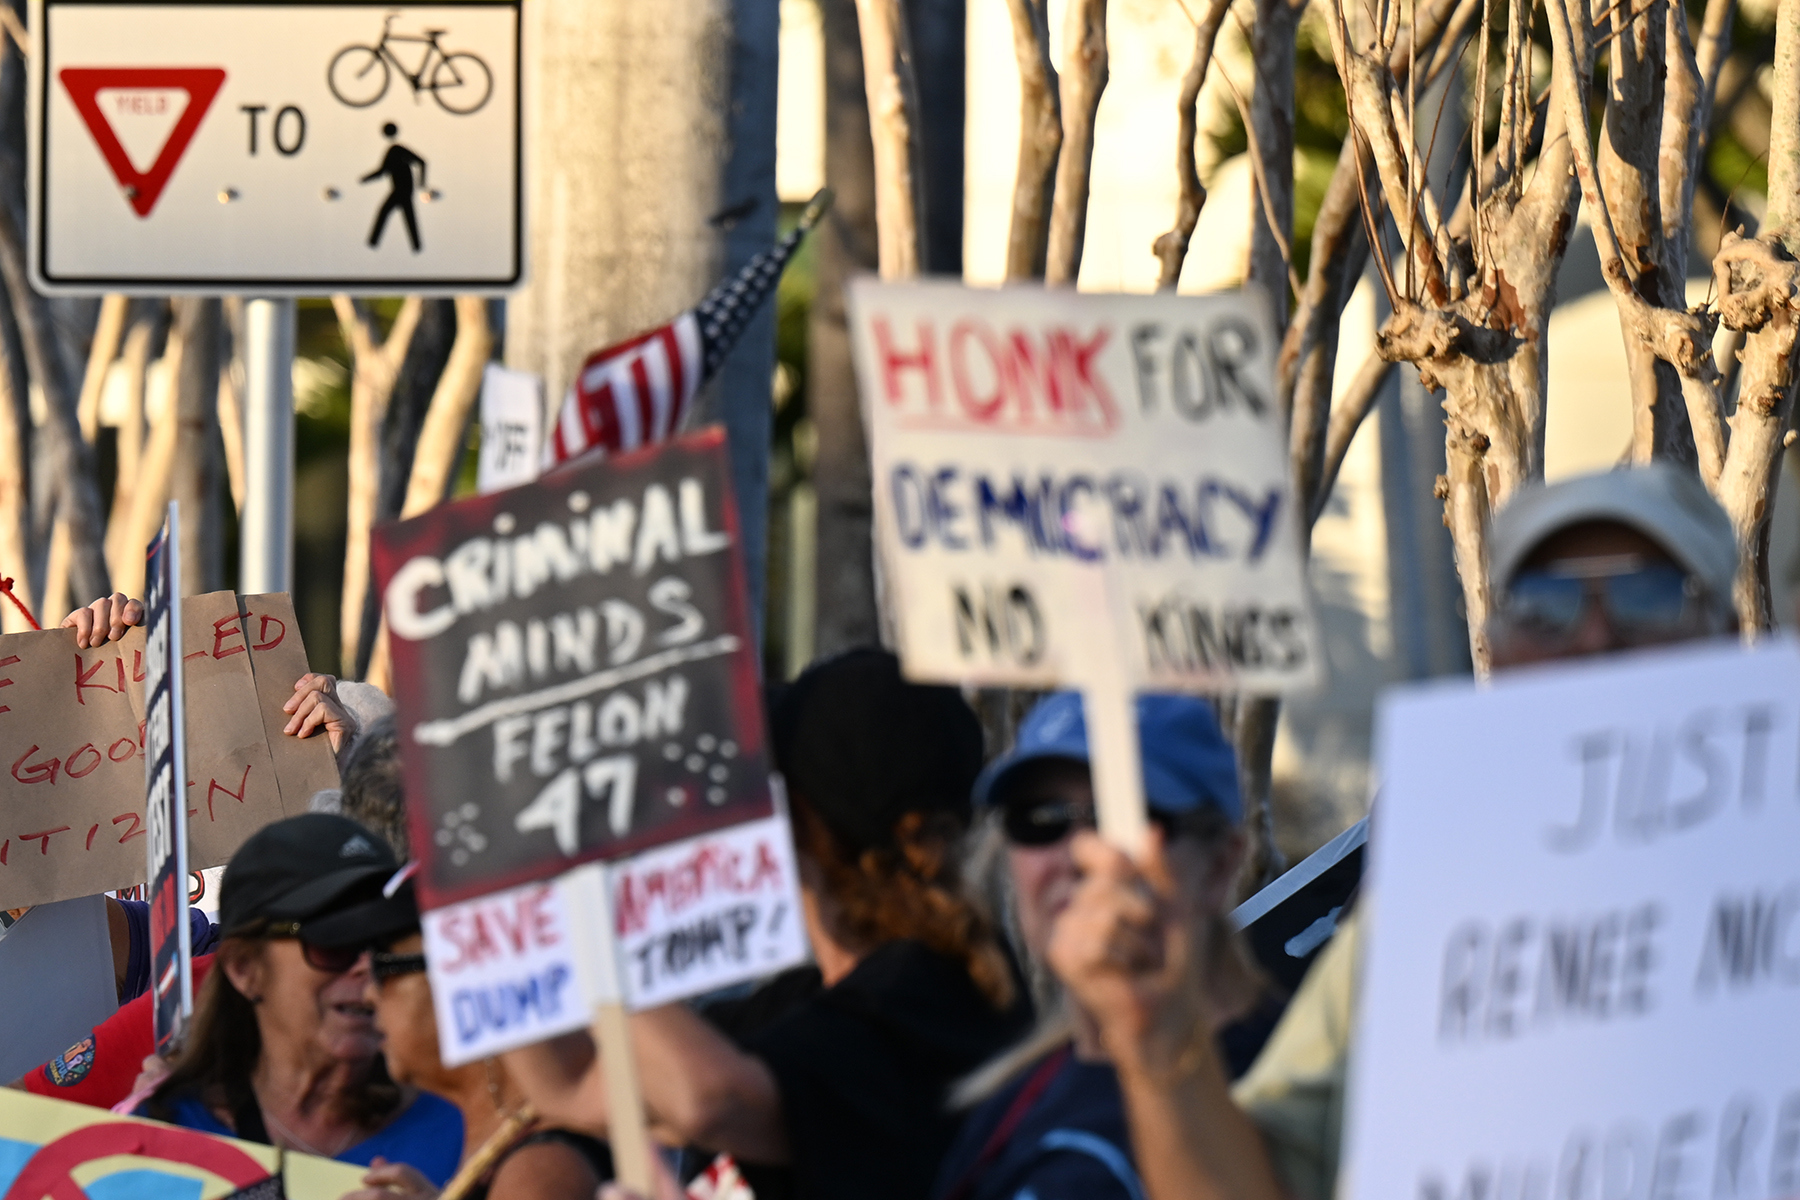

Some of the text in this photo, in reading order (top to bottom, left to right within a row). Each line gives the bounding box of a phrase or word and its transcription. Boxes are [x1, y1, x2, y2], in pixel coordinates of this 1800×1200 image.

[115, 96, 169, 116] YIELD
[239, 104, 306, 157] TO
[868, 313, 1270, 430] HONK FOR
[889, 459, 1284, 565] DEMOCRACY
[73, 610, 287, 706] KILED
[457, 576, 704, 704] MINDS
[952, 577, 1308, 673] NO KINGS
[493, 673, 689, 783] FELON
[1540, 702, 1800, 856] JUST
[514, 752, 637, 856] 47
[439, 880, 562, 974] SAVE
[1436, 897, 1673, 1048] RENEE
[451, 962, 570, 1046] DUMP
